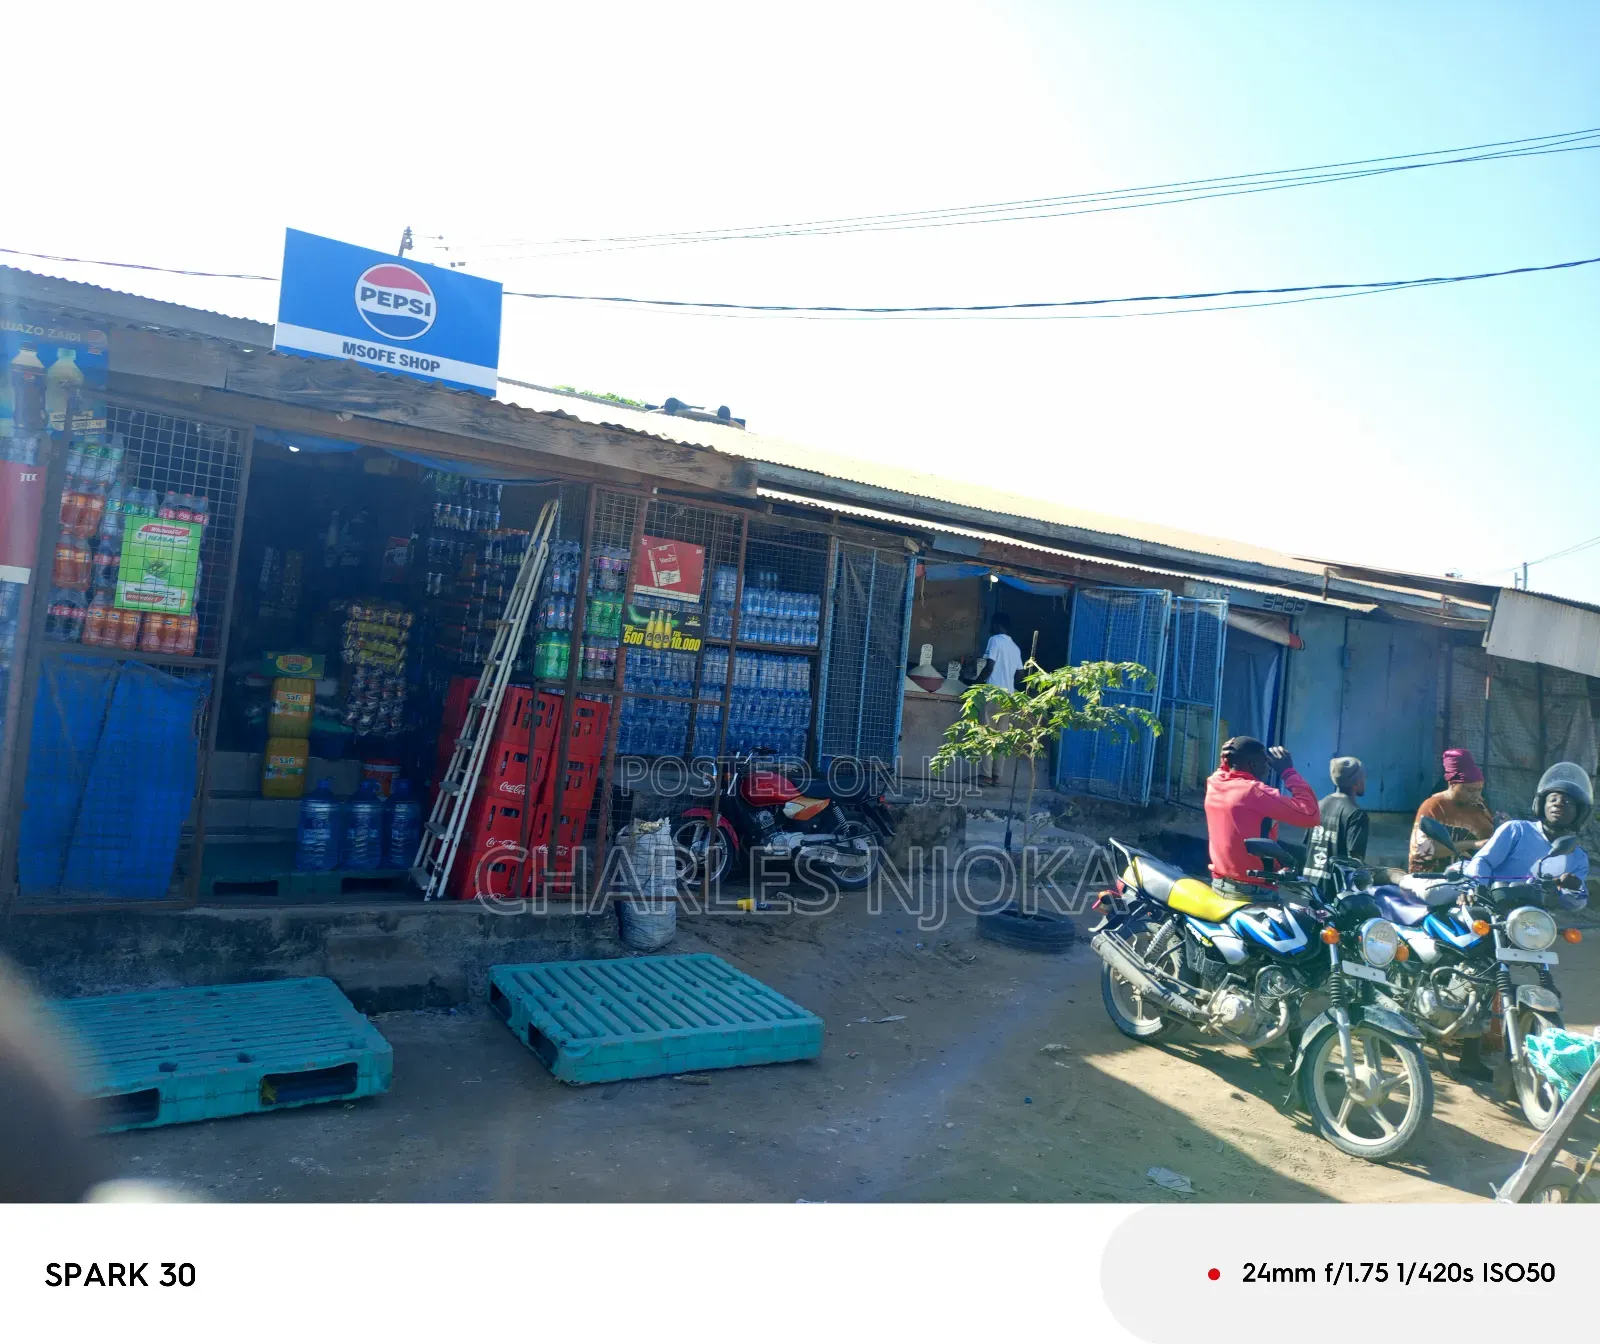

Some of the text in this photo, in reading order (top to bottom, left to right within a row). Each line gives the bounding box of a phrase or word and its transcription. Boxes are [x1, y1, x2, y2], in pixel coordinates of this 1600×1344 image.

[361, 286, 432, 317] PEPSI
[342, 341, 441, 373] MSOFE SHOP
[148, 534, 176, 543] HERBAL
[624, 632, 644, 645] 500
[671, 637, 701, 651] 10.000
[286, 693, 301, 701] Safi
